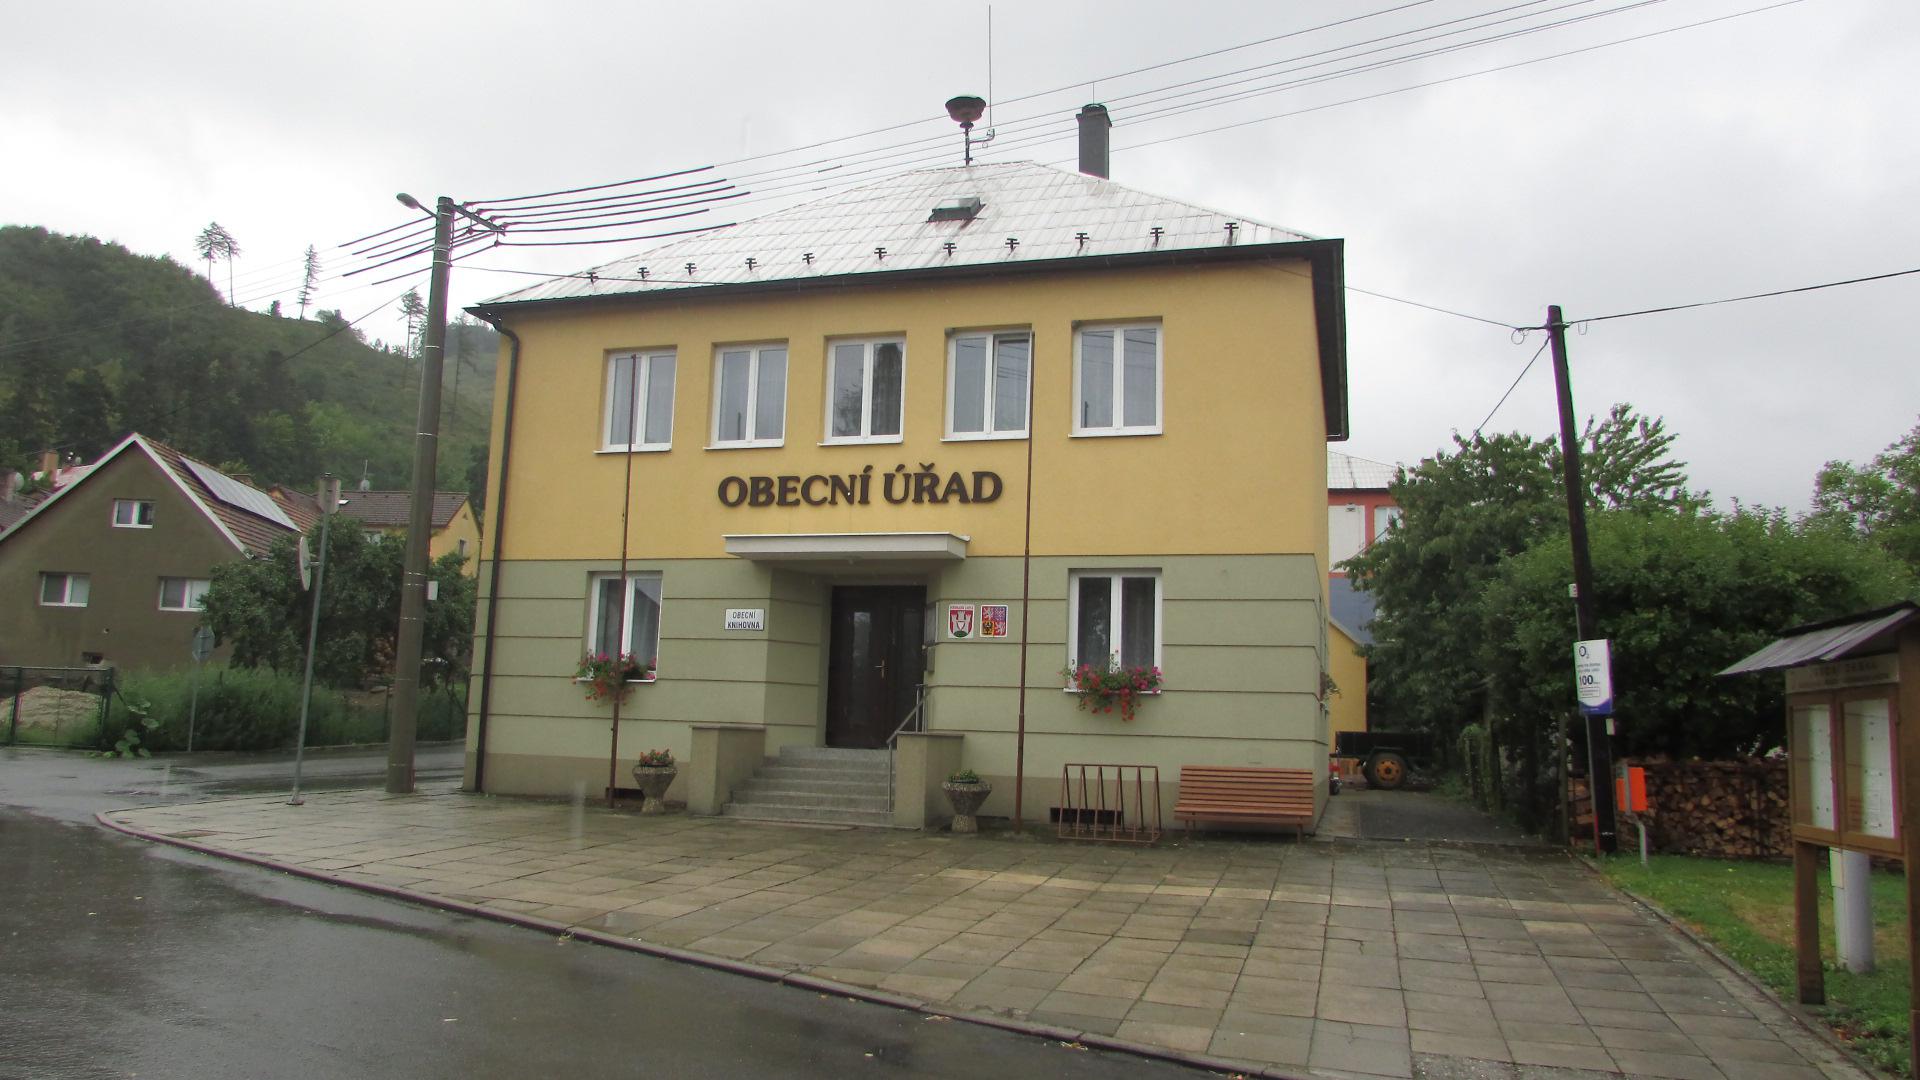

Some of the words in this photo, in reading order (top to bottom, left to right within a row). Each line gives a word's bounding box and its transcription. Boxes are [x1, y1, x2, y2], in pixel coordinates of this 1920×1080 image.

[718, 465, 873, 507] OBECNÍ
[883, 462, 1003, 505] ÚŘAD
[727, 621, 760, 629] KNIHOVNA
[1579, 674, 1594, 686] 100
